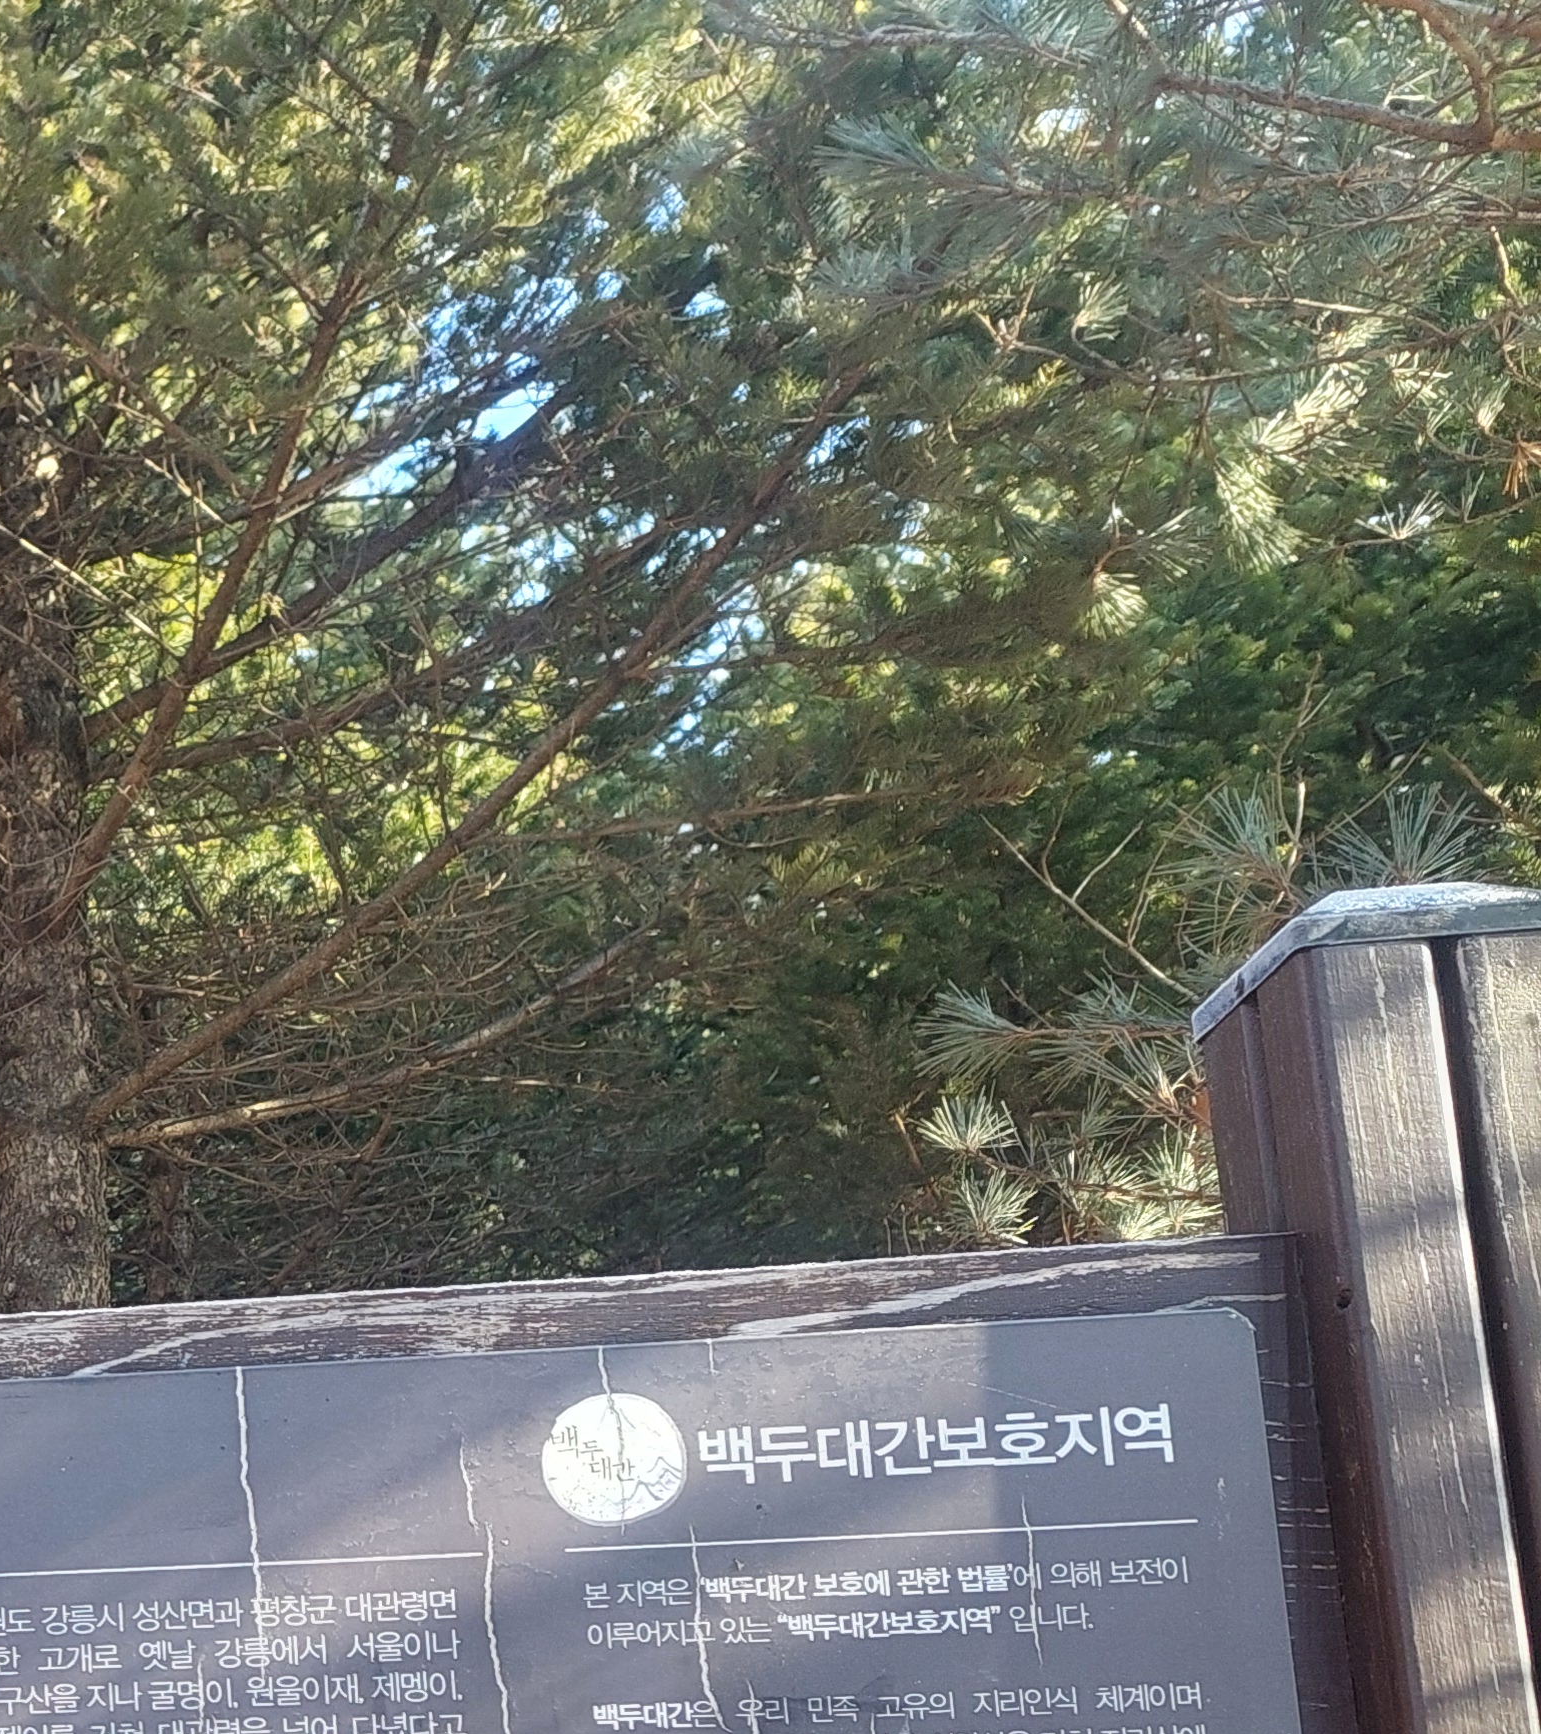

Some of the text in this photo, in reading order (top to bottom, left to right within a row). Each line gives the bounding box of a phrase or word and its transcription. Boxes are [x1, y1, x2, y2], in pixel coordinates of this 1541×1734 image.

[550, 1424, 604, 1462] 백두
[697, 1403, 1174, 1485] 백두대간보호지역
[588, 1456, 636, 1482] 대간
[583, 1582, 610, 1608] 본
[617, 1579, 692, 1607] 지역은
[814, 1570, 890, 1598] 보호에
[897, 1566, 950, 1595] 관한
[1051, 1560, 1101, 1588] 의해
[1108, 1556, 1189, 1585] 보전이
[41, 1602, 124, 1635] 강릉시
[132, 1597, 243, 1632] 성산면과
[251, 1594, 336, 1626] 평창군
[345, 1589, 457, 1623] 대관령면
[587, 1620, 716, 1649] 이루어지고
[720, 1617, 772, 1644] 있는
[1010, 1602, 1094, 1632] 입니다.
[38, 1643, 122, 1674] 고개로
[139, 1640, 195, 1670] 옛날
[214, 1634, 327, 1668] 강릉에서
[346, 1629, 461, 1662] 서울이나
